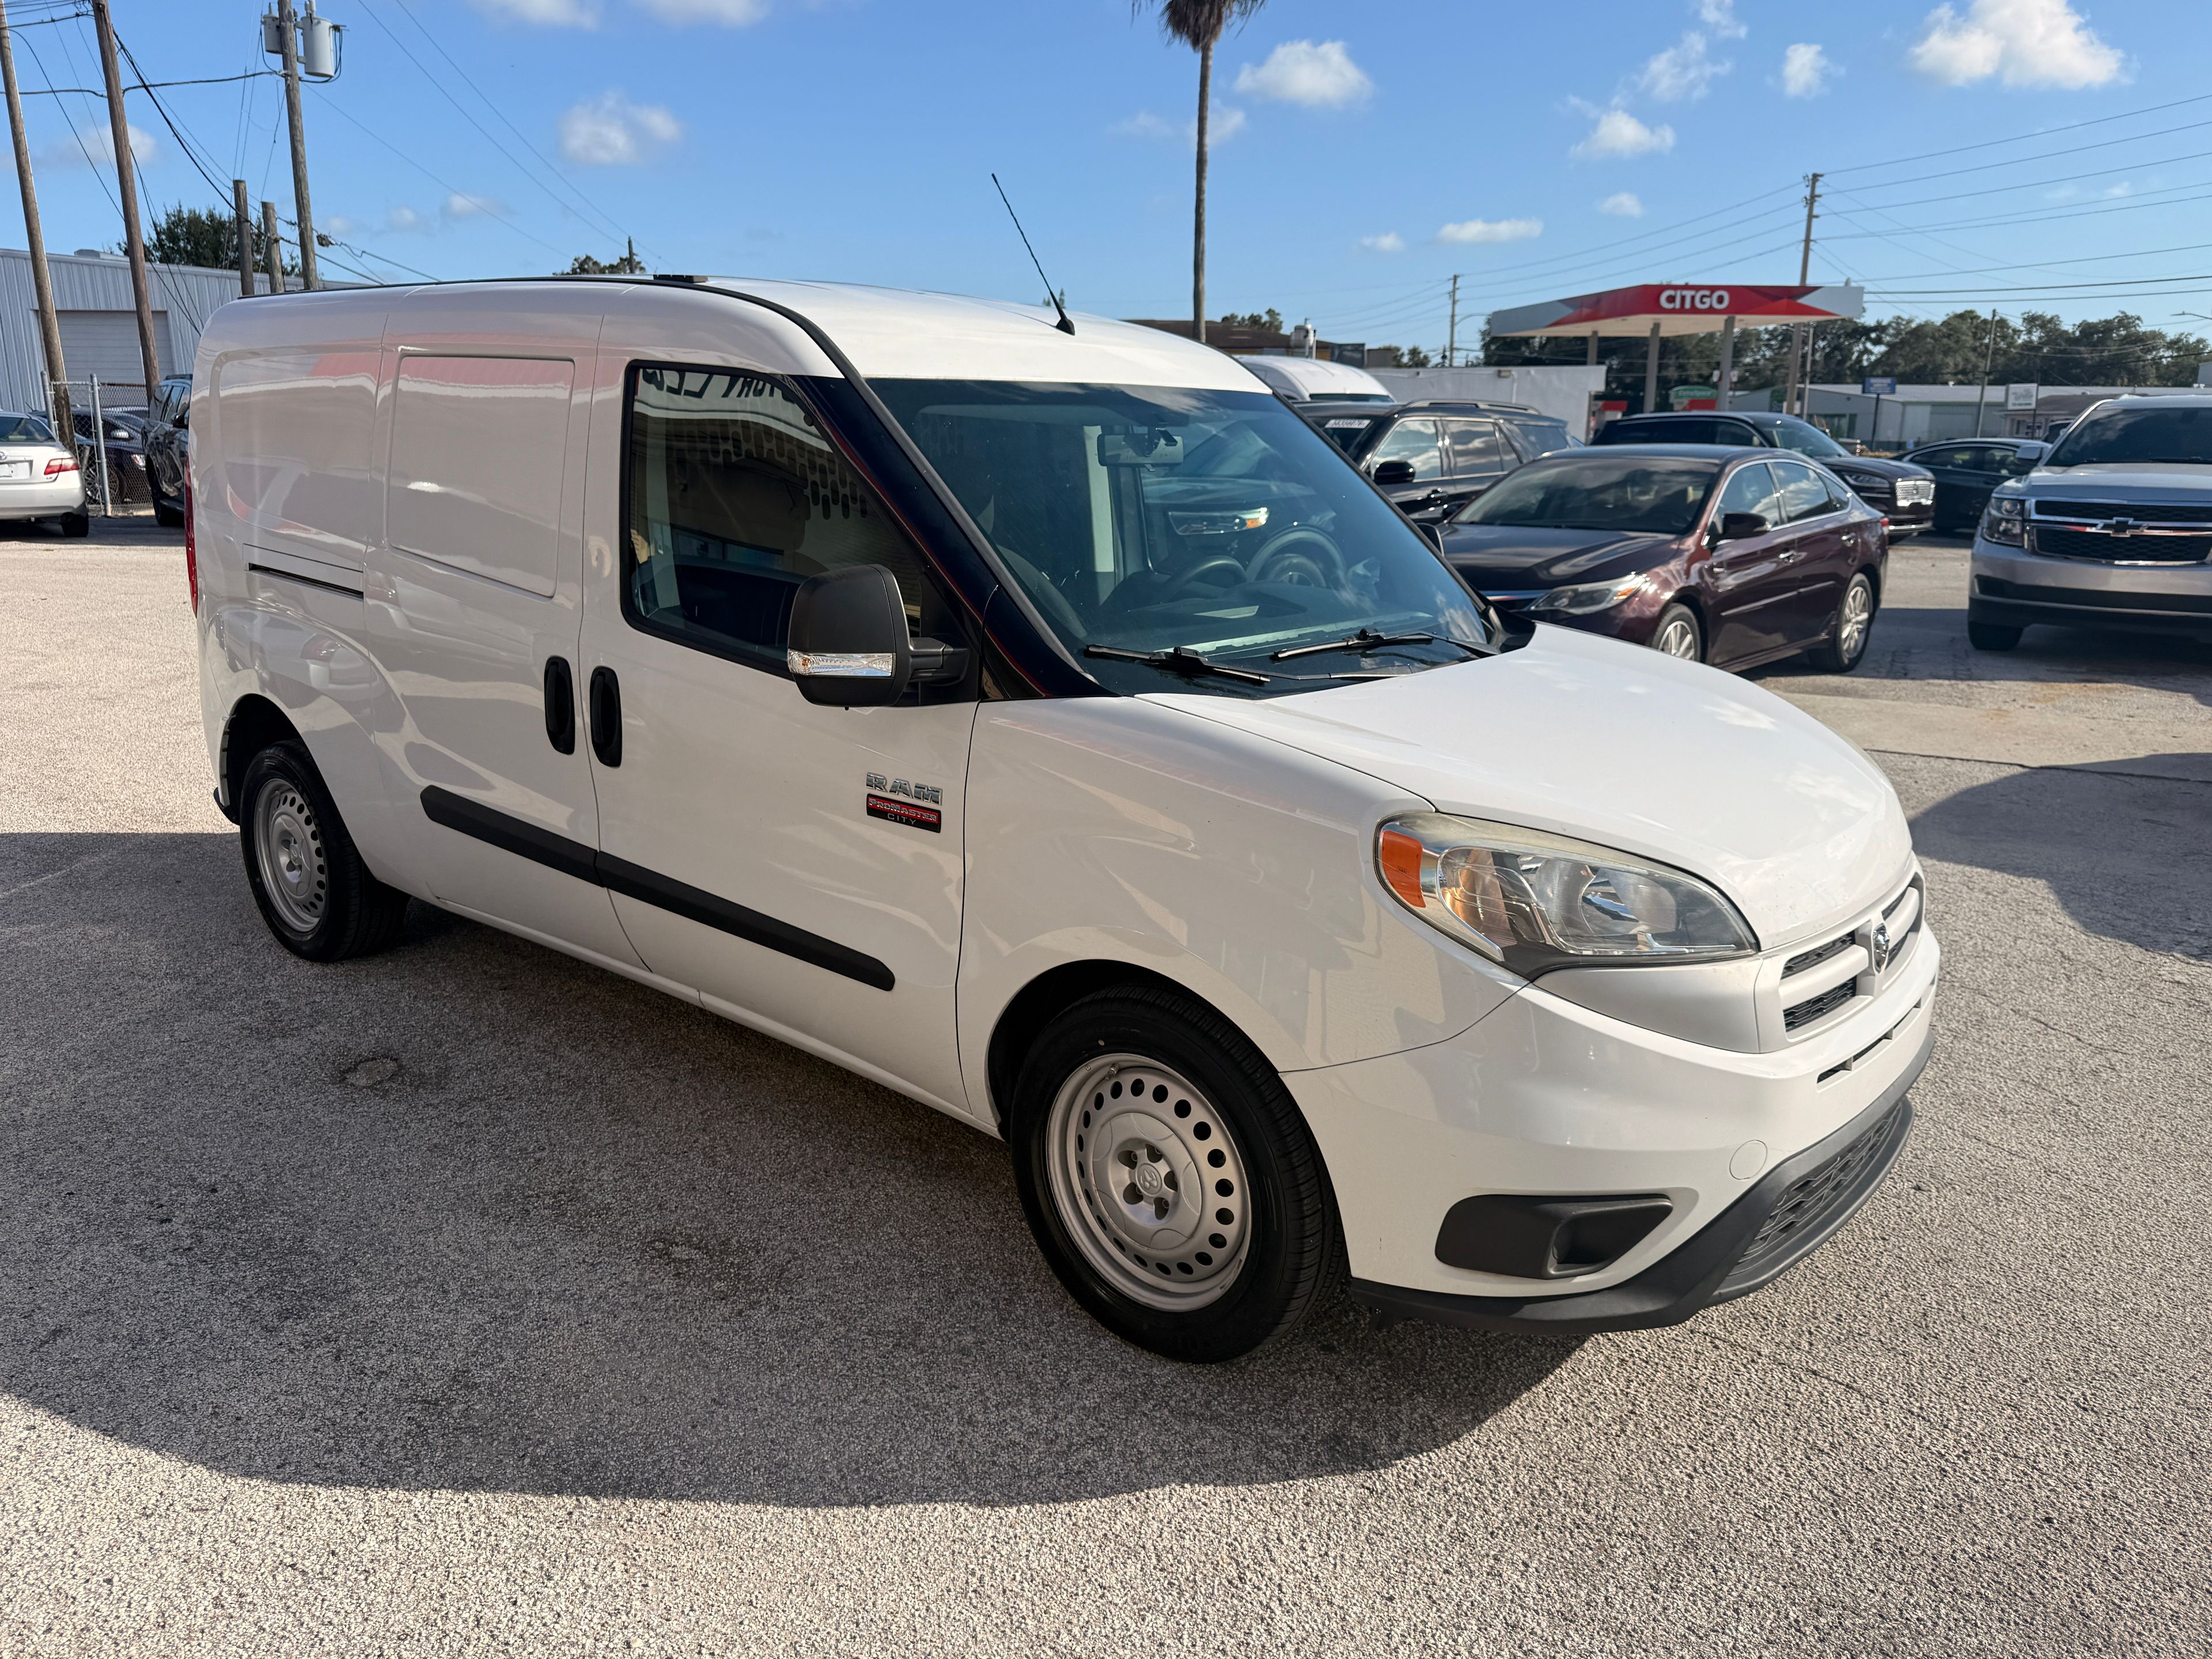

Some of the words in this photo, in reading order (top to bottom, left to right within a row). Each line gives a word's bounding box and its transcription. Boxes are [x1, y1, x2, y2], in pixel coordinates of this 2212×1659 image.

[1660, 290, 1729, 309] CITGO
[866, 772, 943, 806] RAM
[887, 813, 916, 824] CITY
